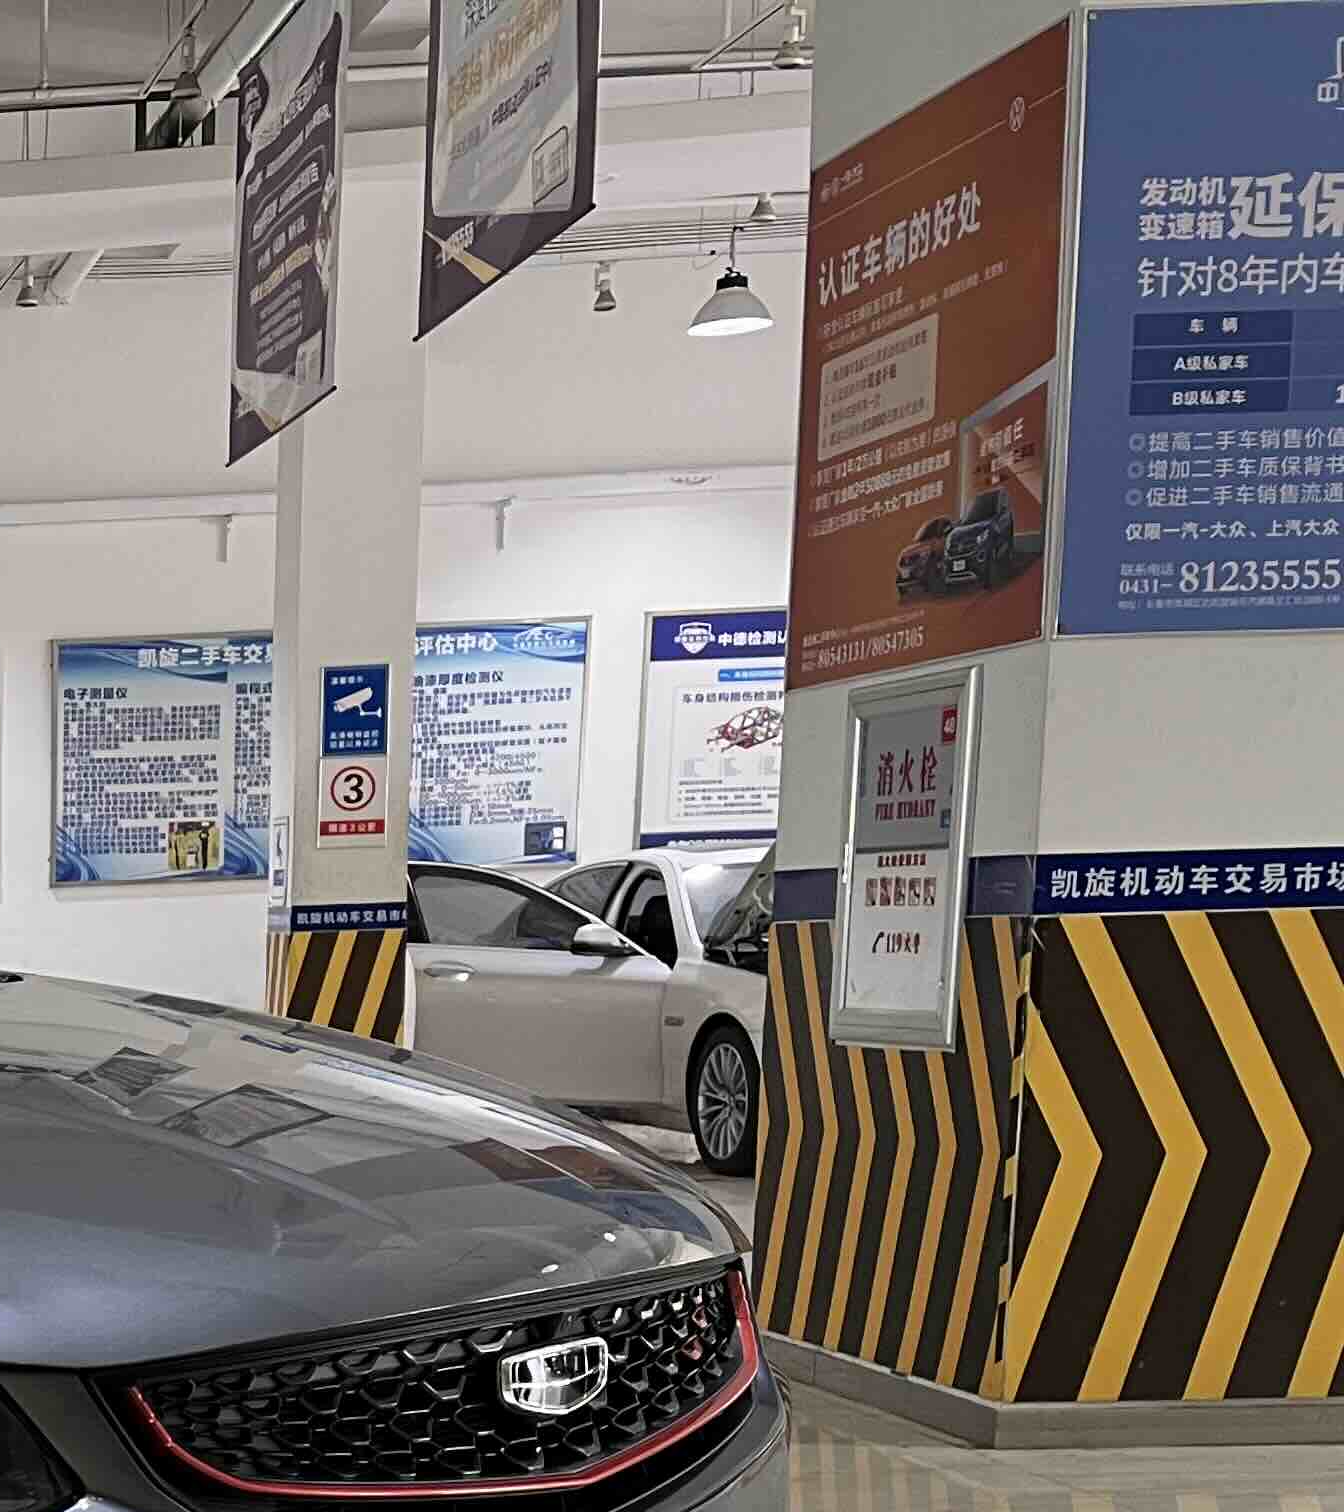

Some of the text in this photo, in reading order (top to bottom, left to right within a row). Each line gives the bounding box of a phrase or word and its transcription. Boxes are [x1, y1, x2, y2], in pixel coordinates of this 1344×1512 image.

[1140, 177, 1226, 207] 发动机
[1228, 171, 1344, 240] 延保
[1138, 212, 1225, 241] 变速箱
[818, 181, 982, 307] 认证车辆的好处
[1174, 354, 1249, 372] A级私家车
[1171, 389, 1248, 407] B级私家车
[1179, 559, 1341, 593] 81235555
[63, 687, 128, 700] 电子测量仪
[877, 745, 938, 796] 消火栓
[343, 774, 365, 804] 3
